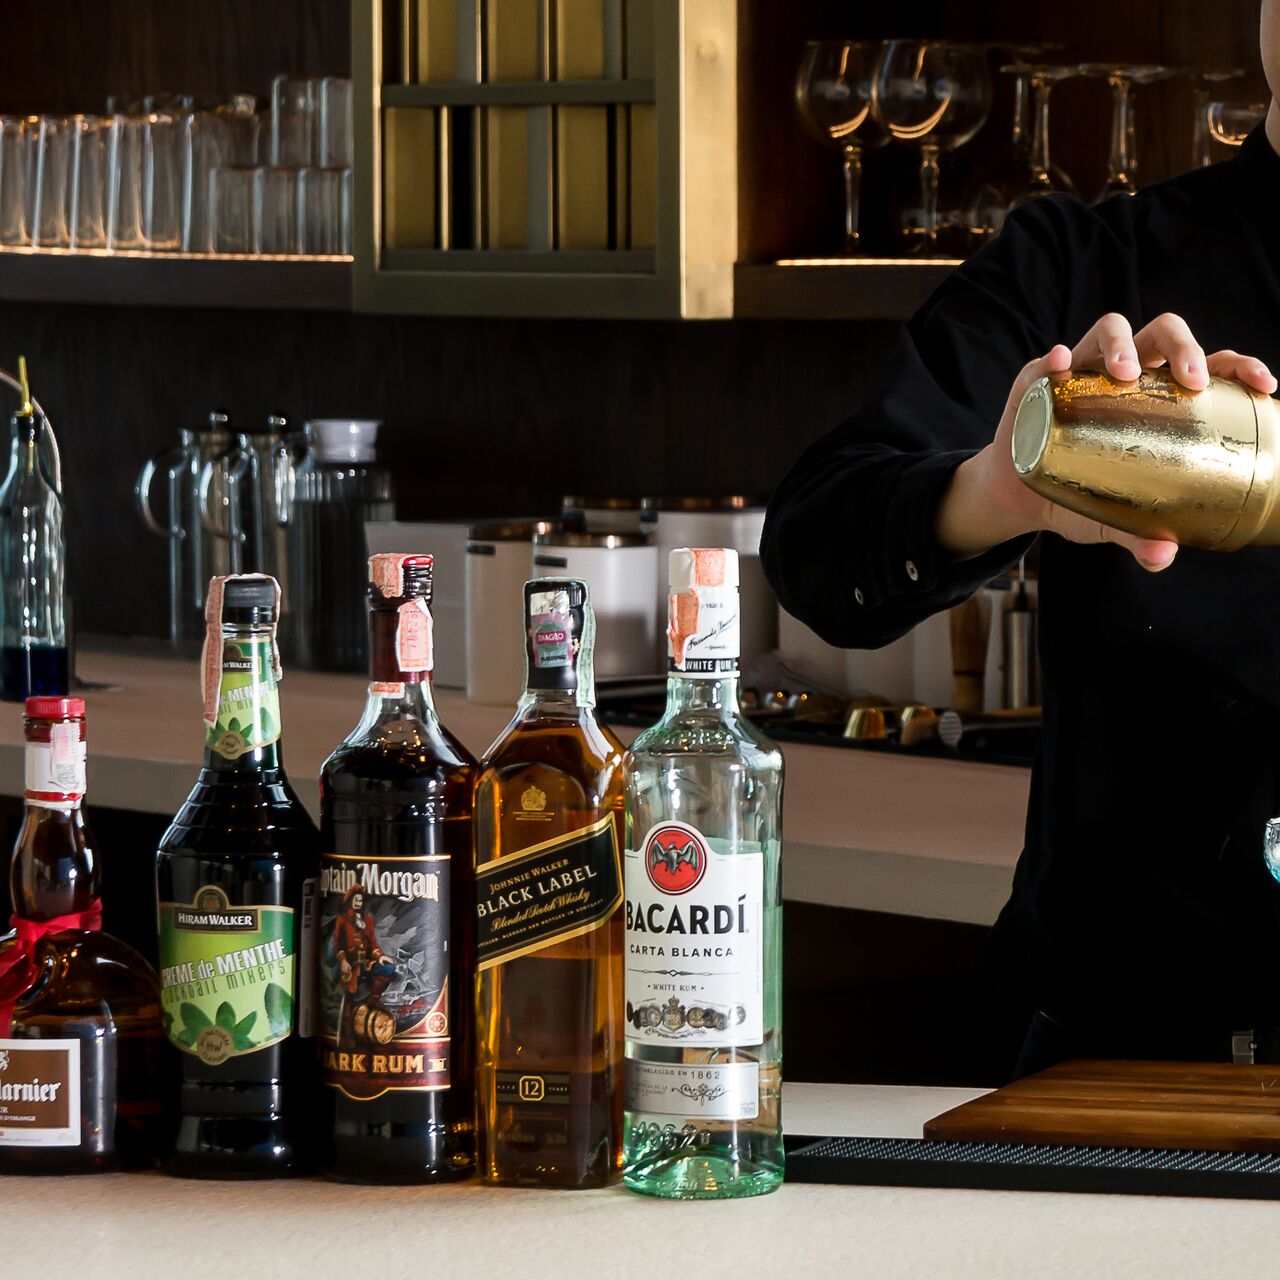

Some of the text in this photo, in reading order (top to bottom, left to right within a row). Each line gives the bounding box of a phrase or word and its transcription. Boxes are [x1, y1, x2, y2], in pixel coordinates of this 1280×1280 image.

[686, 660, 713, 670] WHITE
[320, 862, 439, 903] ptain Morgan
[490, 858, 569, 894] JOHNNIE WALKER
[477, 864, 597, 918] BLACK LABEL
[490, 887, 591, 932] Blended Scotch Whisky
[627, 893, 746, 935] BACARDÍ
[178, 912, 253, 927] HIRAM WALKER
[198, 960, 215, 980] de
[215, 938, 287, 976] MENTHE
[630, 944, 734, 957] CARTA BLANCA
[653, 983, 697, 992] WHITE RUM
[372, 1054, 424, 1073] RUM
[690, 1070, 721, 1080] 1862
[525, 1080, 540, 1096] 12
